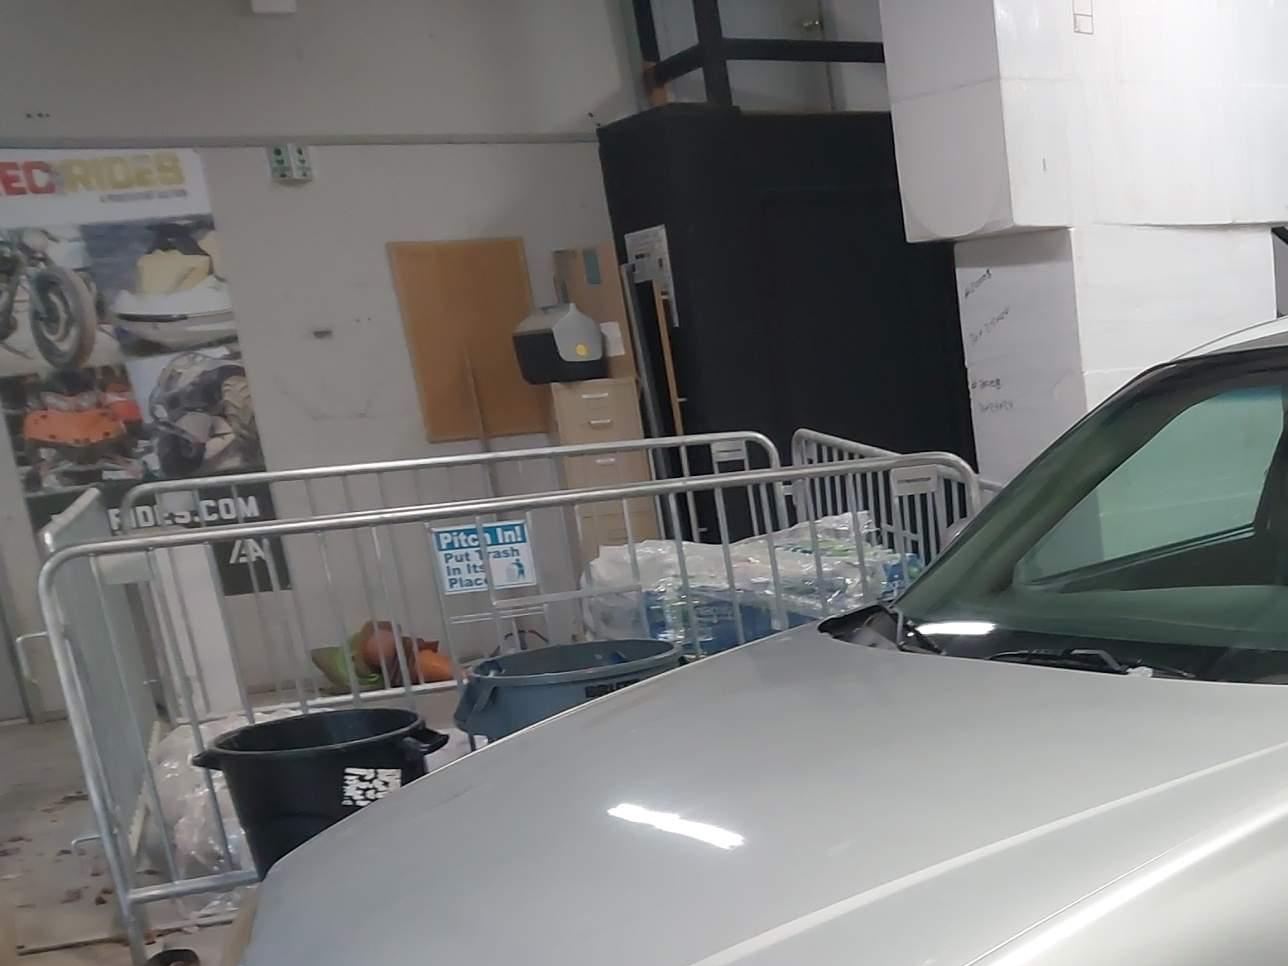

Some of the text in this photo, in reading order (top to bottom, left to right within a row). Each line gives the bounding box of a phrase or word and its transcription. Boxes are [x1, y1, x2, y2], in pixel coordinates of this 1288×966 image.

[496, 525, 523, 544] In!
[444, 551, 471, 564] Put
[446, 565, 461, 577] In
[448, 577, 488, 589] Plac
